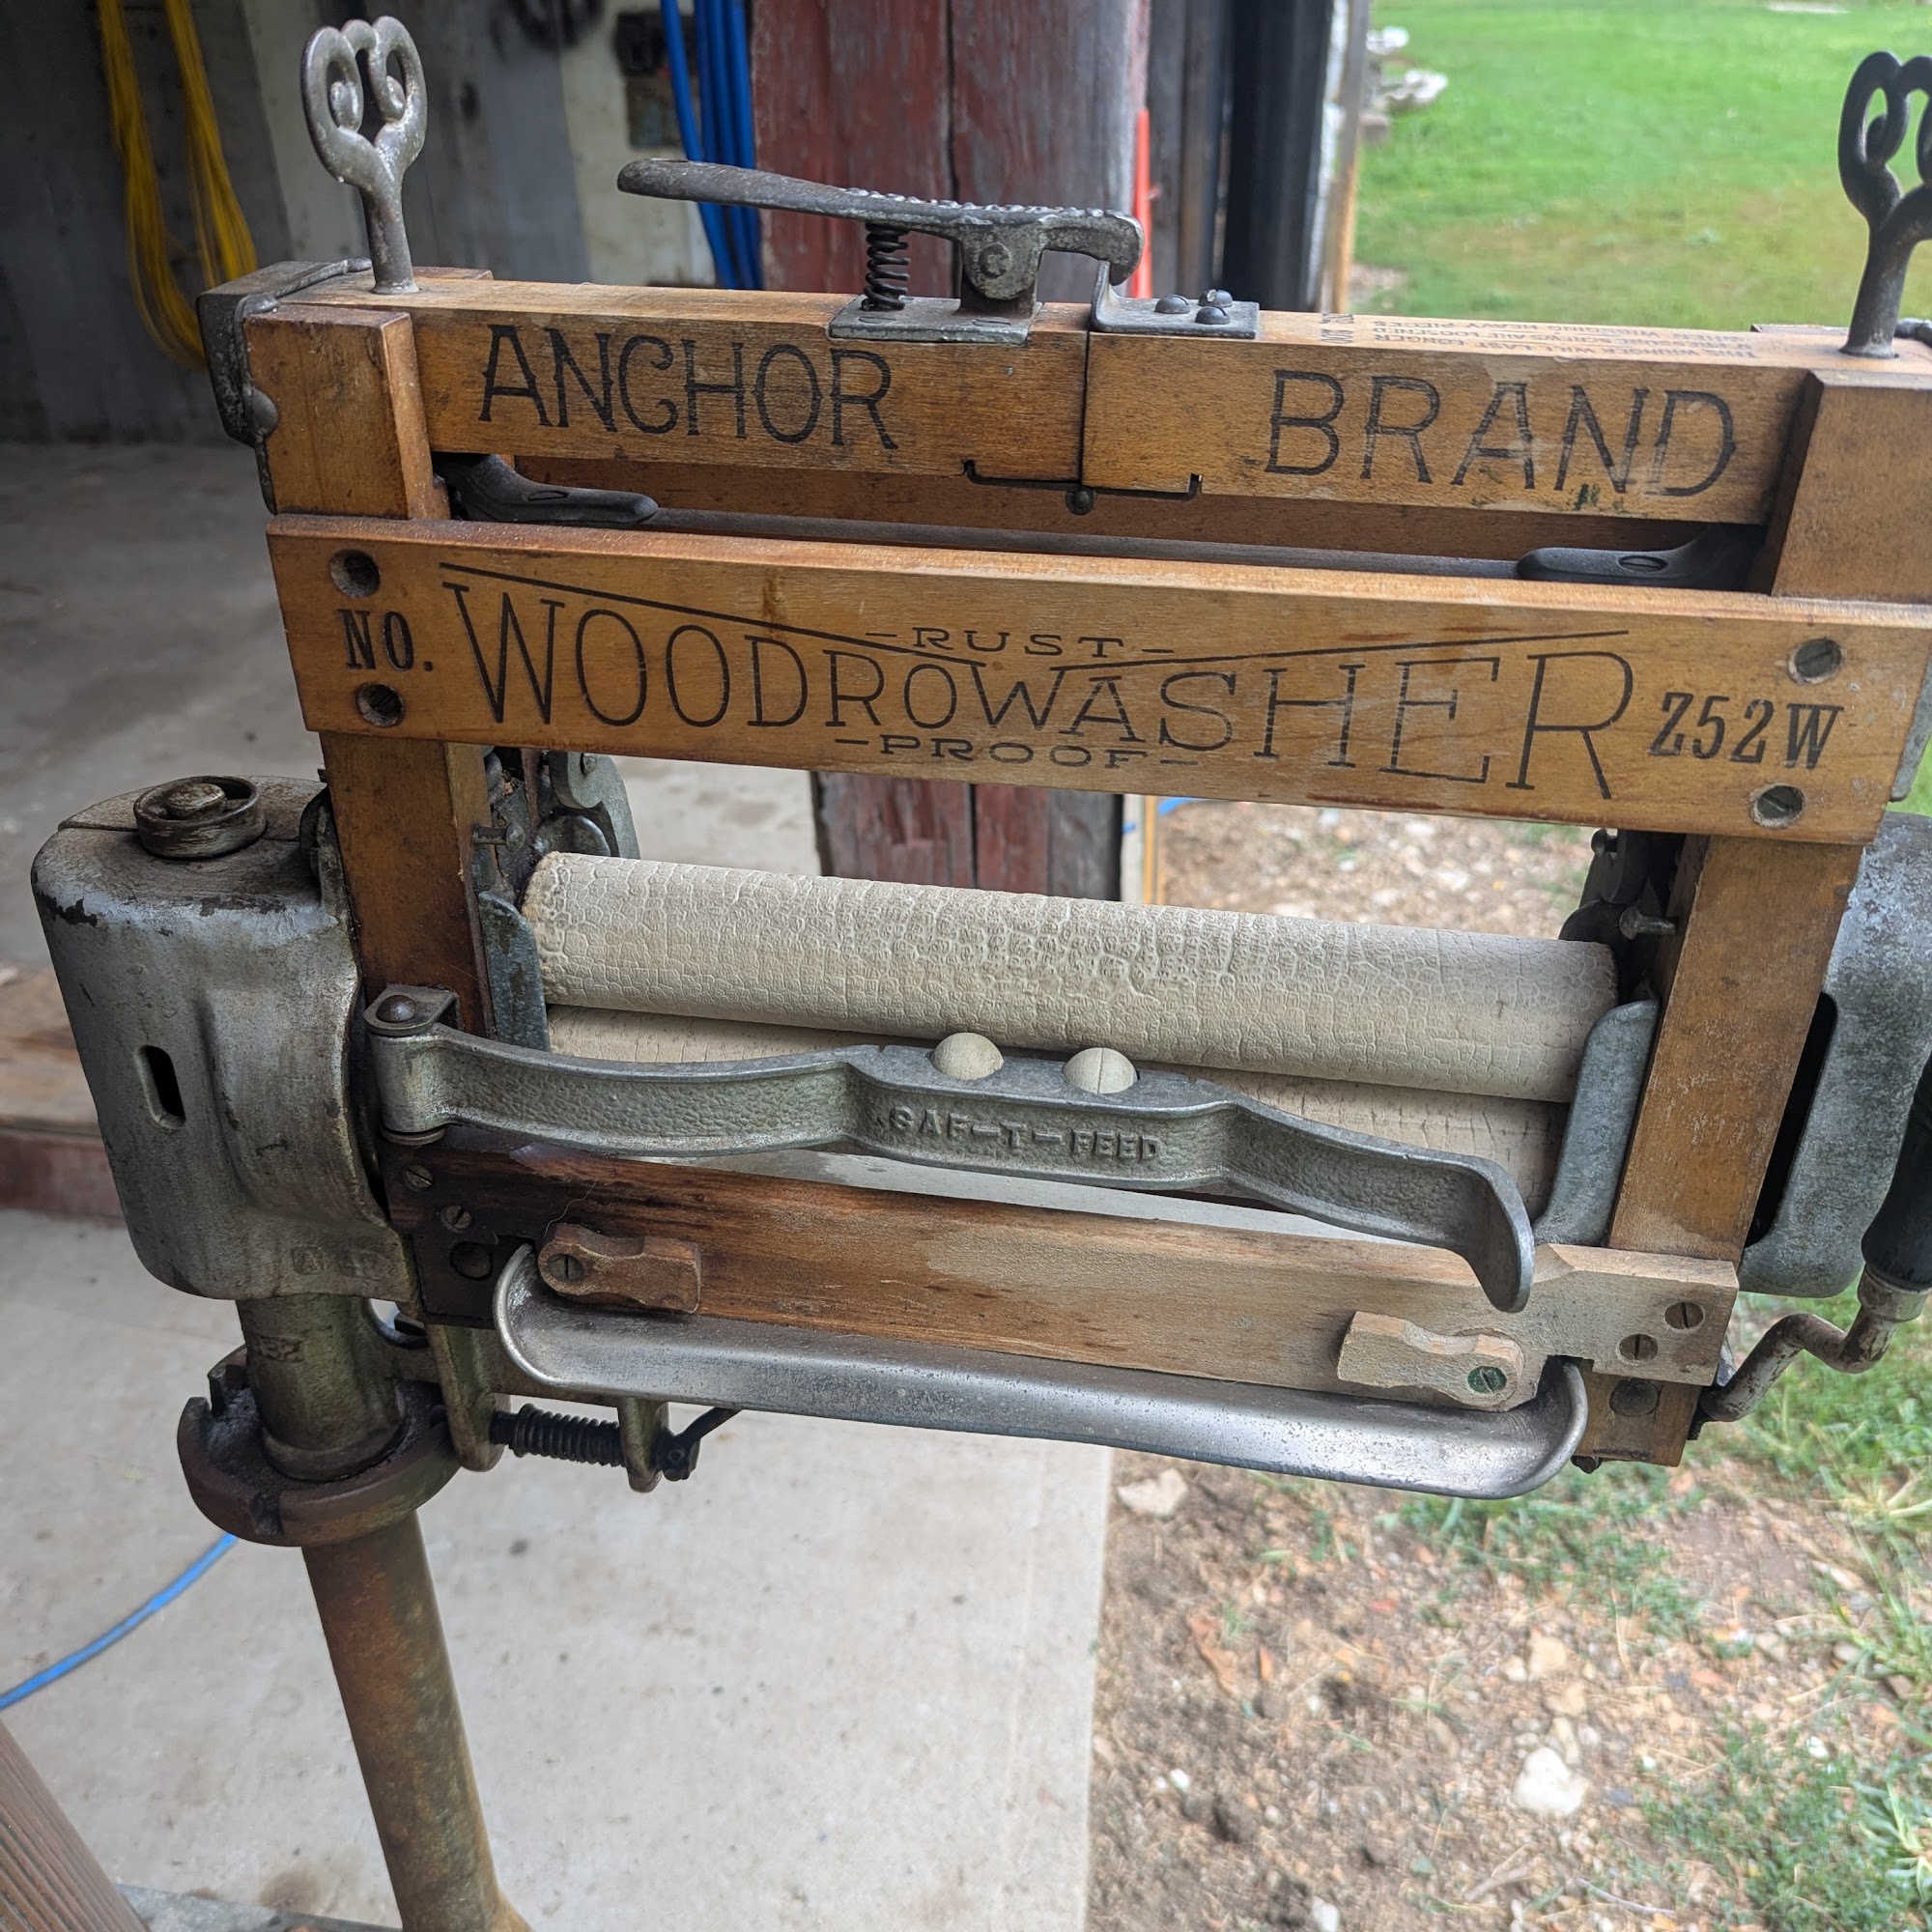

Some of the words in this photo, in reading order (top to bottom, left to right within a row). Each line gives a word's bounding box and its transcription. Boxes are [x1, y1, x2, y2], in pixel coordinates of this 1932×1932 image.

[1373, 320, 1455, 329] PIECES
[1466, 322, 1538, 330] HEAVY
[1373, 327, 1479, 338] LOOSENED
[1548, 326, 1660, 338] WRINGING
[1374, 333, 1464, 346] LONGER
[1530, 333, 1611, 344] SCREWS
[1475, 341, 1531, 352] LAST
[1542, 345, 1596, 354] WILL
[1603, 347, 1698, 356] WRINGER
[478, 325, 898, 449] ANCHOR
[1264, 369, 1737, 497] BRAND
[338, 609, 434, 673] NO.
[441, 581, 1634, 800] WOODROWASHER
[1648, 691, 1844, 770] Z52W
